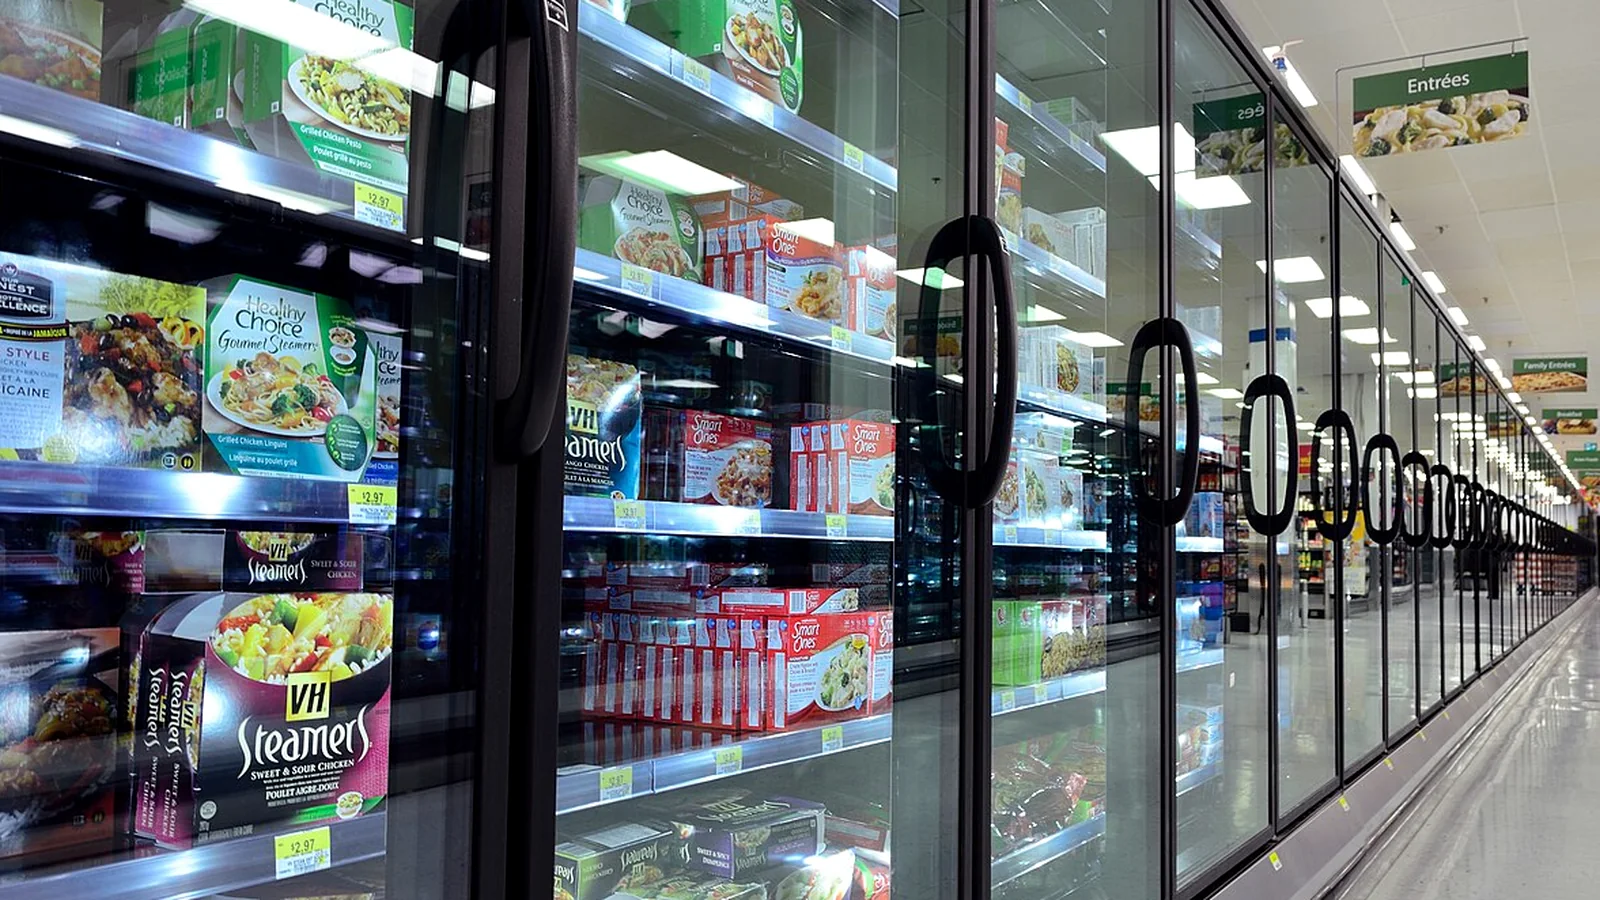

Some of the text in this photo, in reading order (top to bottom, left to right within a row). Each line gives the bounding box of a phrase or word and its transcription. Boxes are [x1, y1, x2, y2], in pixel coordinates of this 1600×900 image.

[1407, 72, 1470, 94] Entrées
[300, 125, 363, 149] Grilled Chicken Pesto
[369, 192, 390, 208] $2.97
[627, 194, 663, 217] Choice
[771, 222, 799, 245] Smart
[772, 238, 796, 256] Ones
[245, 295, 307, 323] Healthy
[235, 309, 303, 338] Choice
[218, 329, 317, 354] Gourmet Steamers
[6, 346, 50, 362] STYLE
[1524, 361, 1577, 370] Family Entrées
[570, 406, 596, 430] VH
[692, 414, 723, 432] Smart
[217, 435, 239, 444] Grilled
[240, 437, 264, 447] Chicken
[693, 429, 720, 445] Ones
[852, 424, 881, 441] Smart
[854, 439, 877, 454] Ones
[264, 457, 284, 465] poulet
[584, 461, 610, 471] CHICKEN
[362, 491, 384, 503] $2.97
[270, 543, 287, 559] VH
[247, 556, 306, 586] Steamers
[327, 570, 357, 578] CHICKEN
[791, 621, 820, 639] Smart
[793, 635, 817, 653] Ones
[144, 668, 166, 749] Steamers
[291, 682, 327, 715] VH
[166, 670, 188, 757] Steamers
[237, 704, 370, 780] Steamers
[172, 763, 180, 797] SWEET
[250, 759, 355, 781] SWEET & SOUR CHICKEN
[265, 788, 295, 801] POULET
[295, 781, 340, 796] AIGRE-DOUX
[140, 781, 150, 827] CHICKEN
[162, 788, 171, 836] CHICKEN
[168, 809, 178, 839] SOUR
[291, 838, 315, 854] $2.97
[697, 846, 712, 856] SWEET
[717, 851, 730, 861] SPICY
